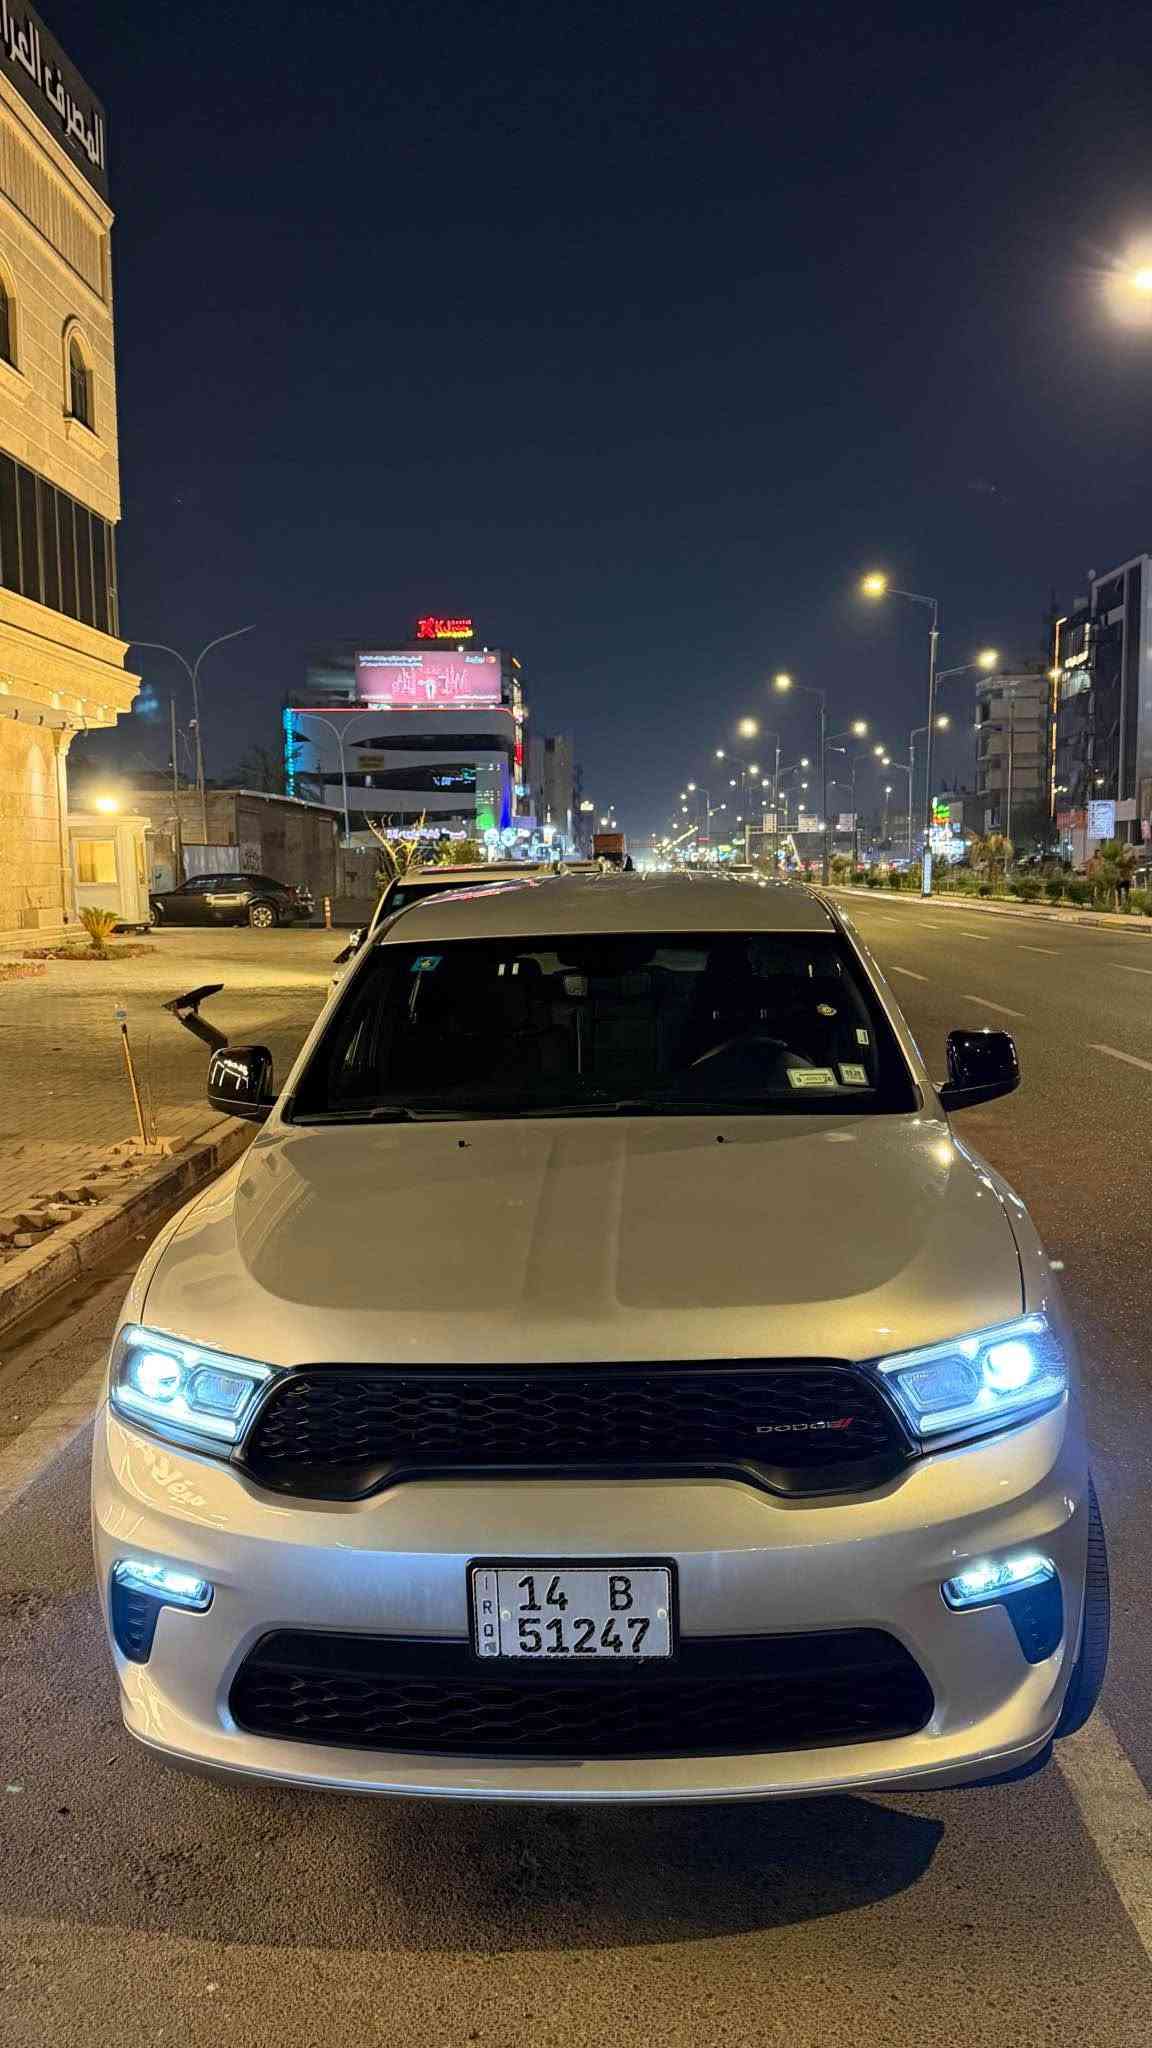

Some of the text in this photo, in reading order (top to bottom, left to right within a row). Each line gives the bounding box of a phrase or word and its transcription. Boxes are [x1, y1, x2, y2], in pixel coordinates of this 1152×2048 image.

[0, 0, 104, 170] المصرف العرا
[756, 1421, 832, 1433] DODGE
[518, 1575, 634, 1611] 14 B
[518, 1617, 650, 1653] 51247
